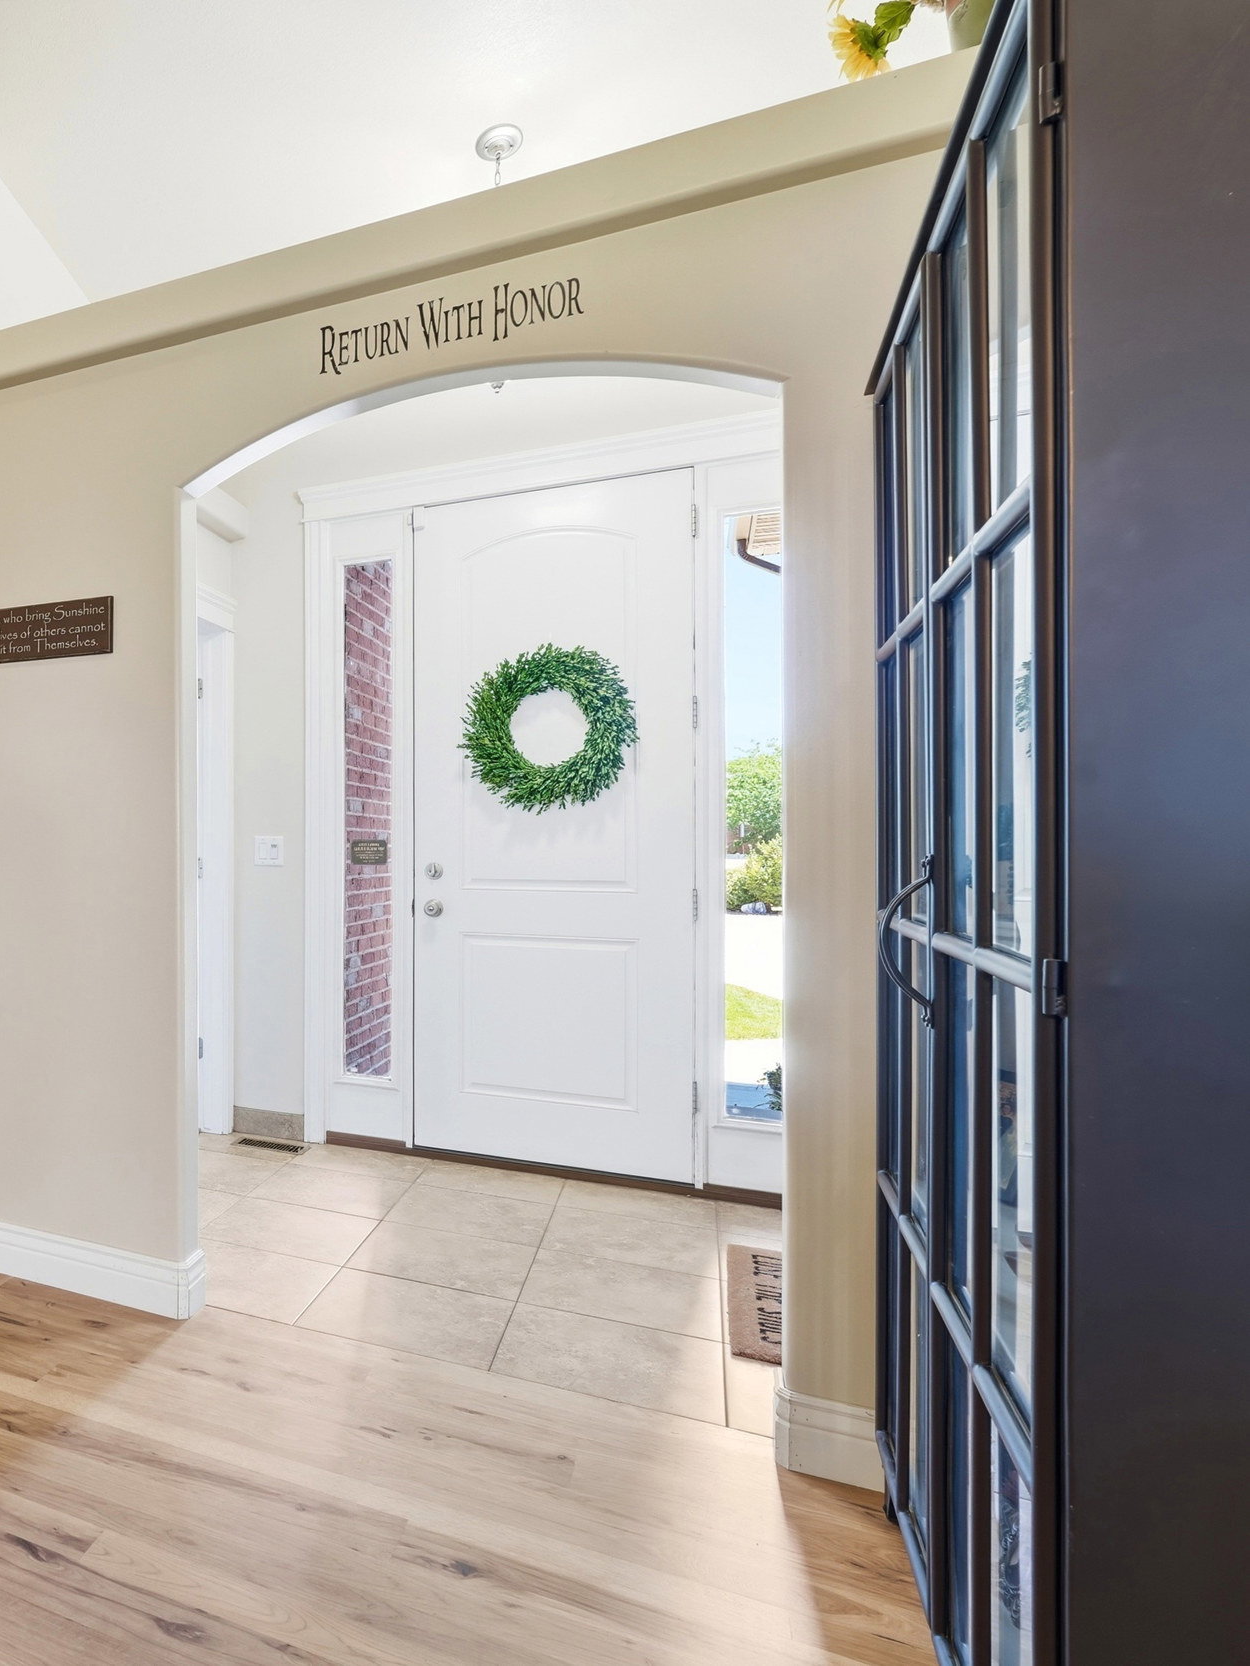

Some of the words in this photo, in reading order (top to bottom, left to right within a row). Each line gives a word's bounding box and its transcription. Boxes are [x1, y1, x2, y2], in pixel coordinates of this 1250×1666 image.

[3, 610, 23, 624] who
[25, 608, 51, 624] bring
[52, 602, 105, 621] Sunshine
[20, 624, 32, 639] of
[33, 623, 66, 638] others
[68, 621, 106, 634] cannot
[0, 644, 7, 654] it
[9, 640, 31, 653] from
[33, 634, 99, 653] Themselves.
